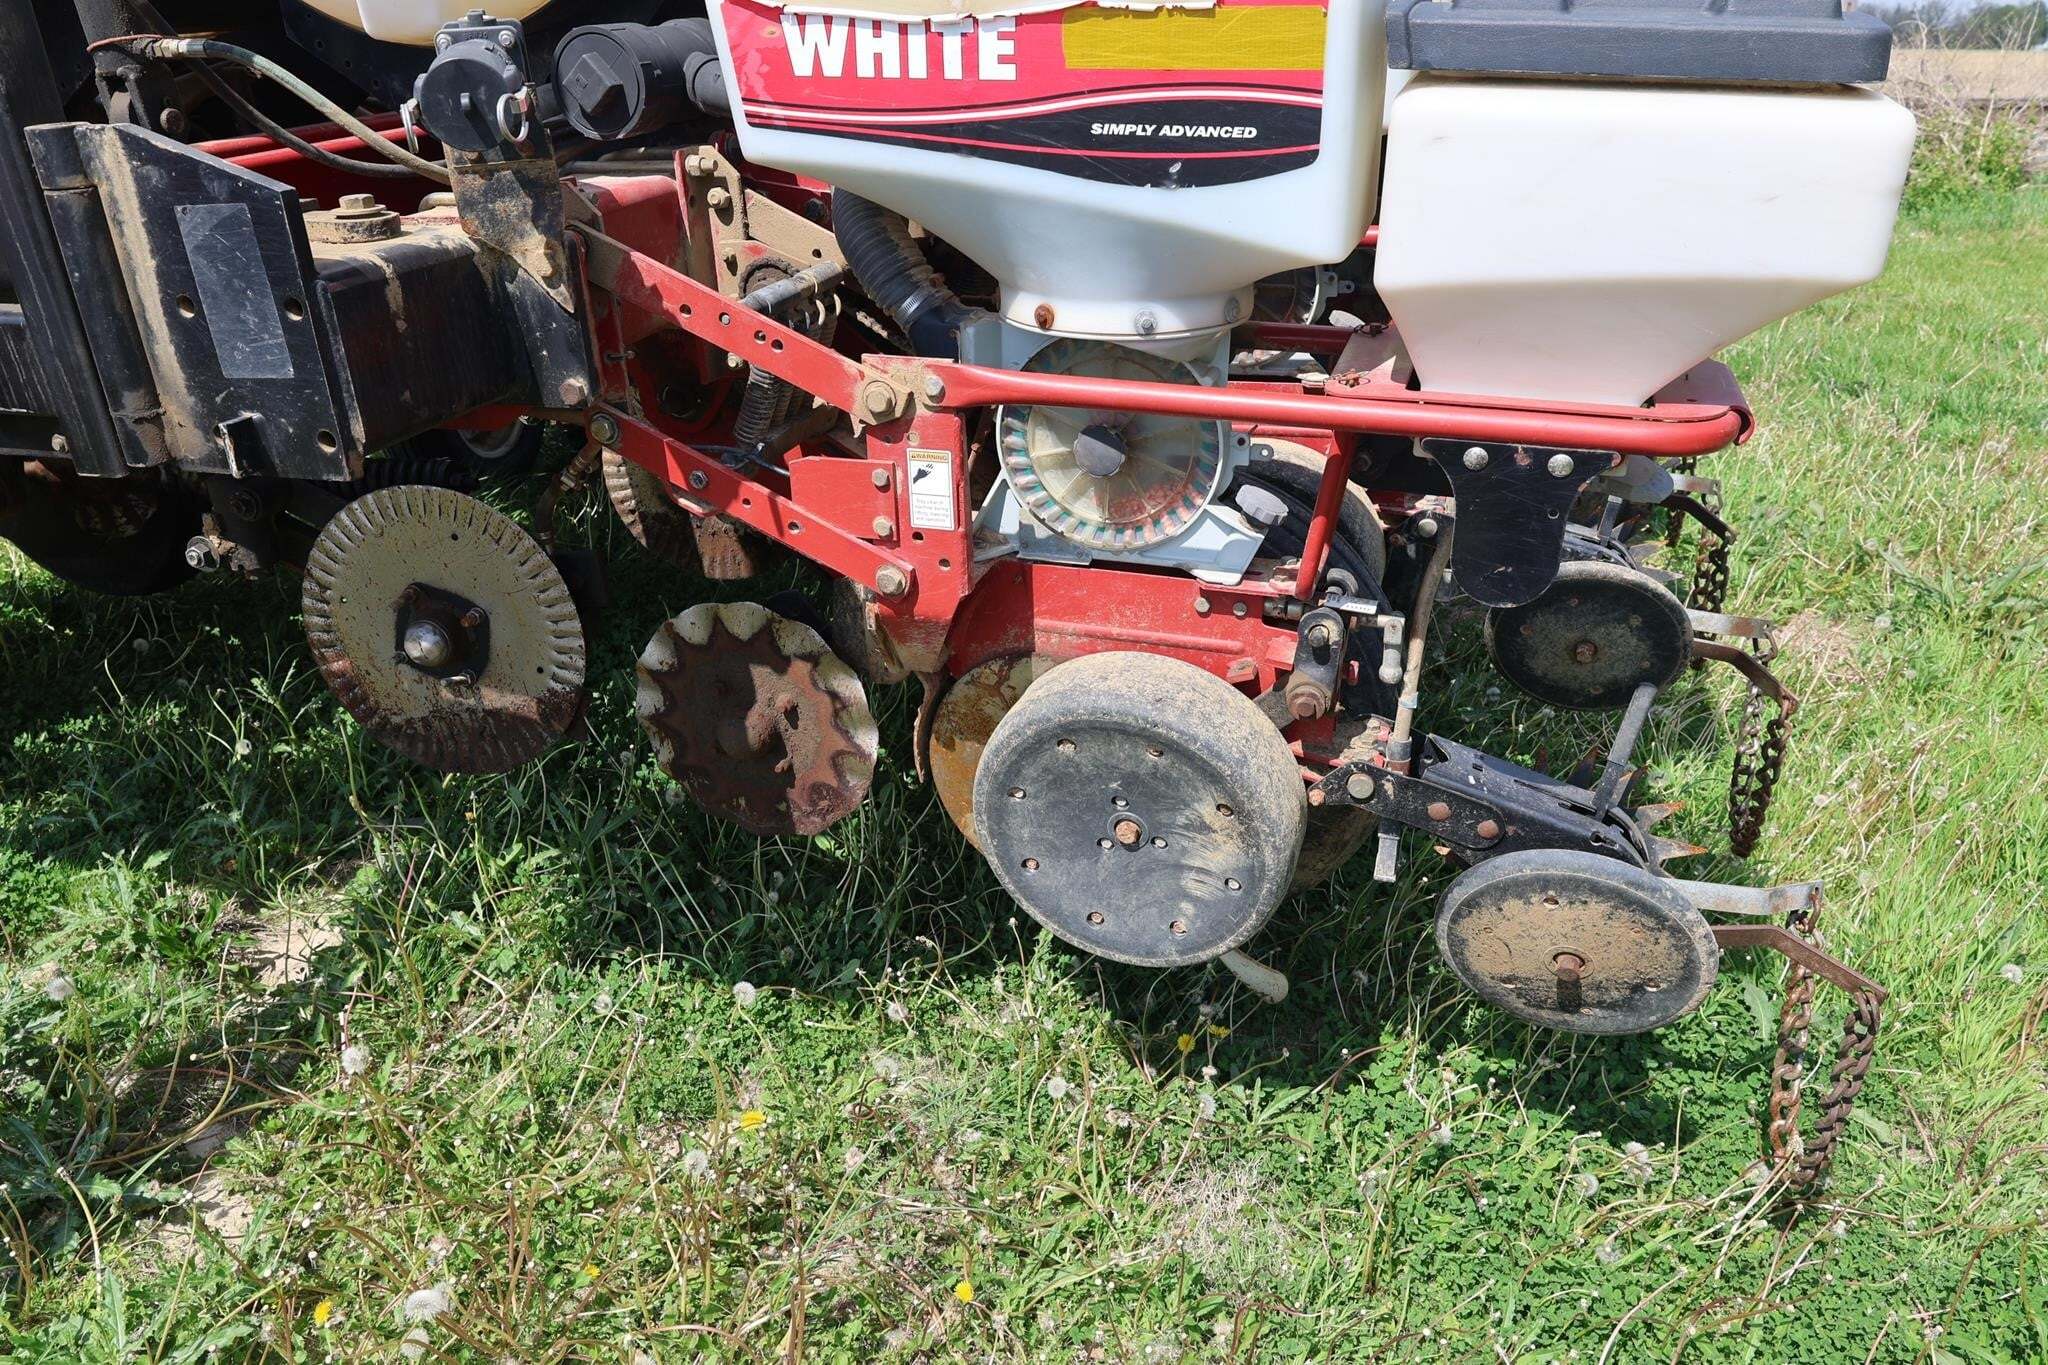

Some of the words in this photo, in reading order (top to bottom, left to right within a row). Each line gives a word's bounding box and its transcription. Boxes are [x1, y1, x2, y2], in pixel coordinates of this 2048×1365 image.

[780, 14, 1018, 81] WHITE
[1090, 122, 1157, 136] SIMPLY
[1158, 124, 1258, 139] ADVANCED
